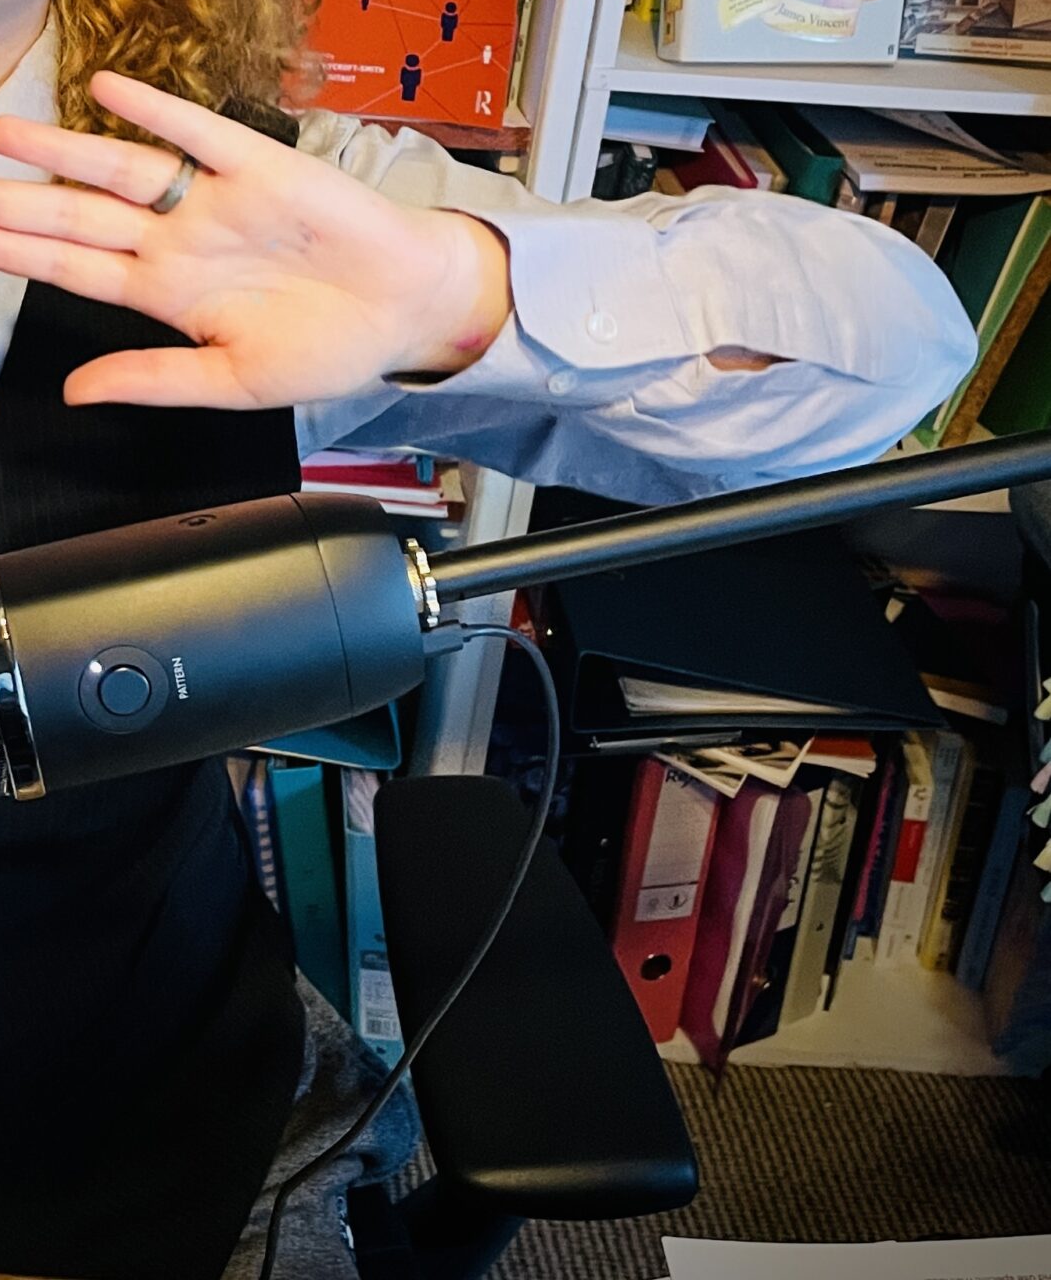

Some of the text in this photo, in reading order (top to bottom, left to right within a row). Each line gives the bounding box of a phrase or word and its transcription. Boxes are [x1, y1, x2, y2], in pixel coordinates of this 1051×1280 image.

[777, 3, 850, 29] James Vincent
[475, 90, 492, 115] R
[171, 657, 189, 700] PATTERN
